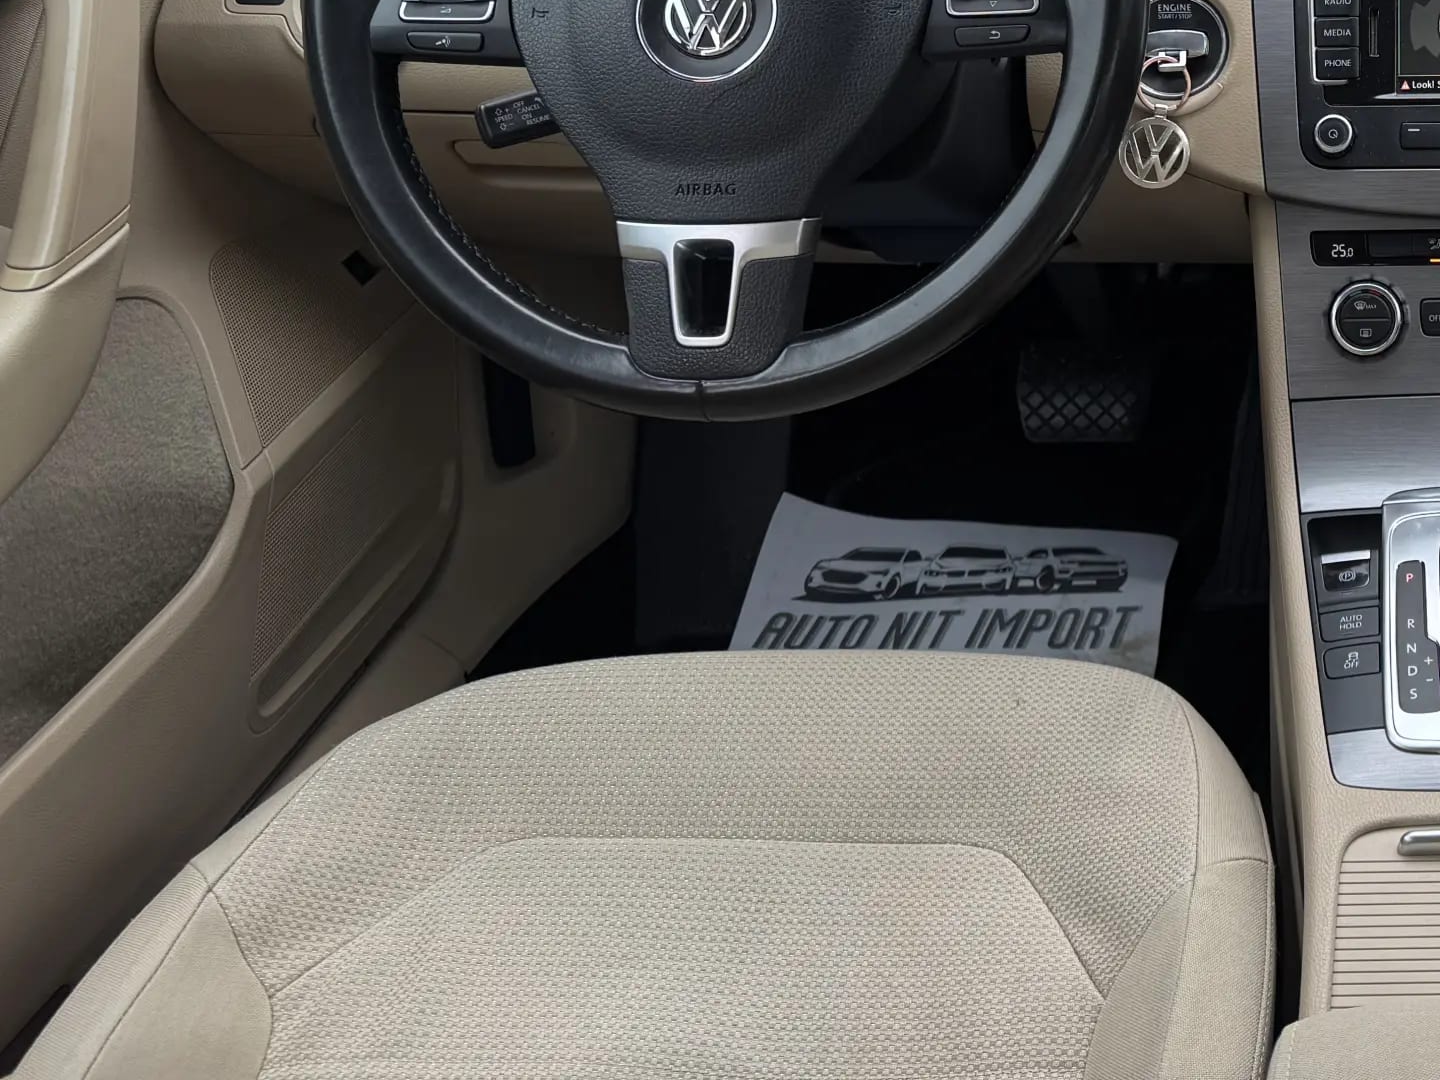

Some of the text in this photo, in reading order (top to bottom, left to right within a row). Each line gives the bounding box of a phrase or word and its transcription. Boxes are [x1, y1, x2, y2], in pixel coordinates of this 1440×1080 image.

[1157, 3, 1192, 11] ENGINE
[1323, 28, 1352, 37] MEDIA
[1324, 59, 1352, 67] PHONE
[1412, 80, 1435, 89] Look!
[674, 183, 737, 195] AIRBAG
[1405, 572, 1414, 582] P
[1340, 614, 1363, 623] AUTO
[1407, 618, 1415, 629] R
[751, 605, 1145, 651] AUTO NIT IMPORT
[1339, 621, 1362, 631] HOLD
[1406, 642, 1417, 654] N
[1407, 665, 1418, 677] D
[1409, 688, 1418, 700] S
